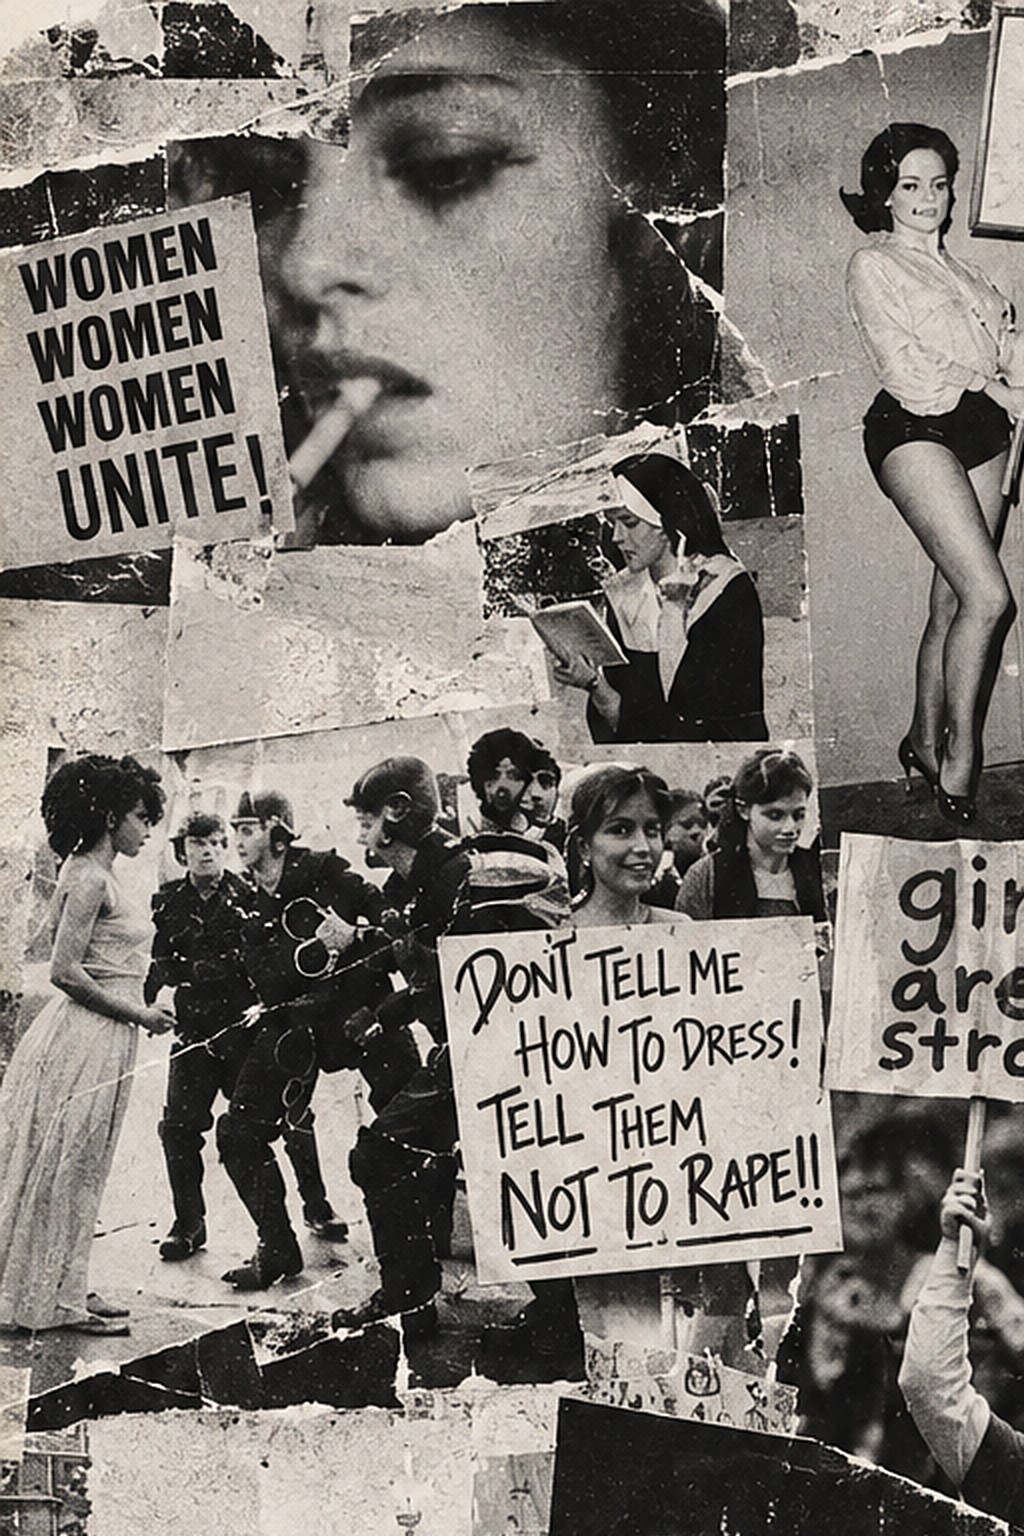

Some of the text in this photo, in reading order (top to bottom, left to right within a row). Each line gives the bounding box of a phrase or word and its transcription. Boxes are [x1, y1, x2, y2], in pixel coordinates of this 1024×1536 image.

[19, 217, 217, 314] WOMEN
[27, 287, 224, 384] WOMEN
[37, 358, 235, 454] WOMEN
[57, 433, 272, 540] UNITE!
[585, 947, 680, 1006] TELL
[688, 949, 743, 996] ME
[515, 999, 801, 1084] HOW TO DRESS!
[477, 1086, 707, 1161] TELL THEM
[500, 1134, 824, 1250] NOT TO RAPE!!
